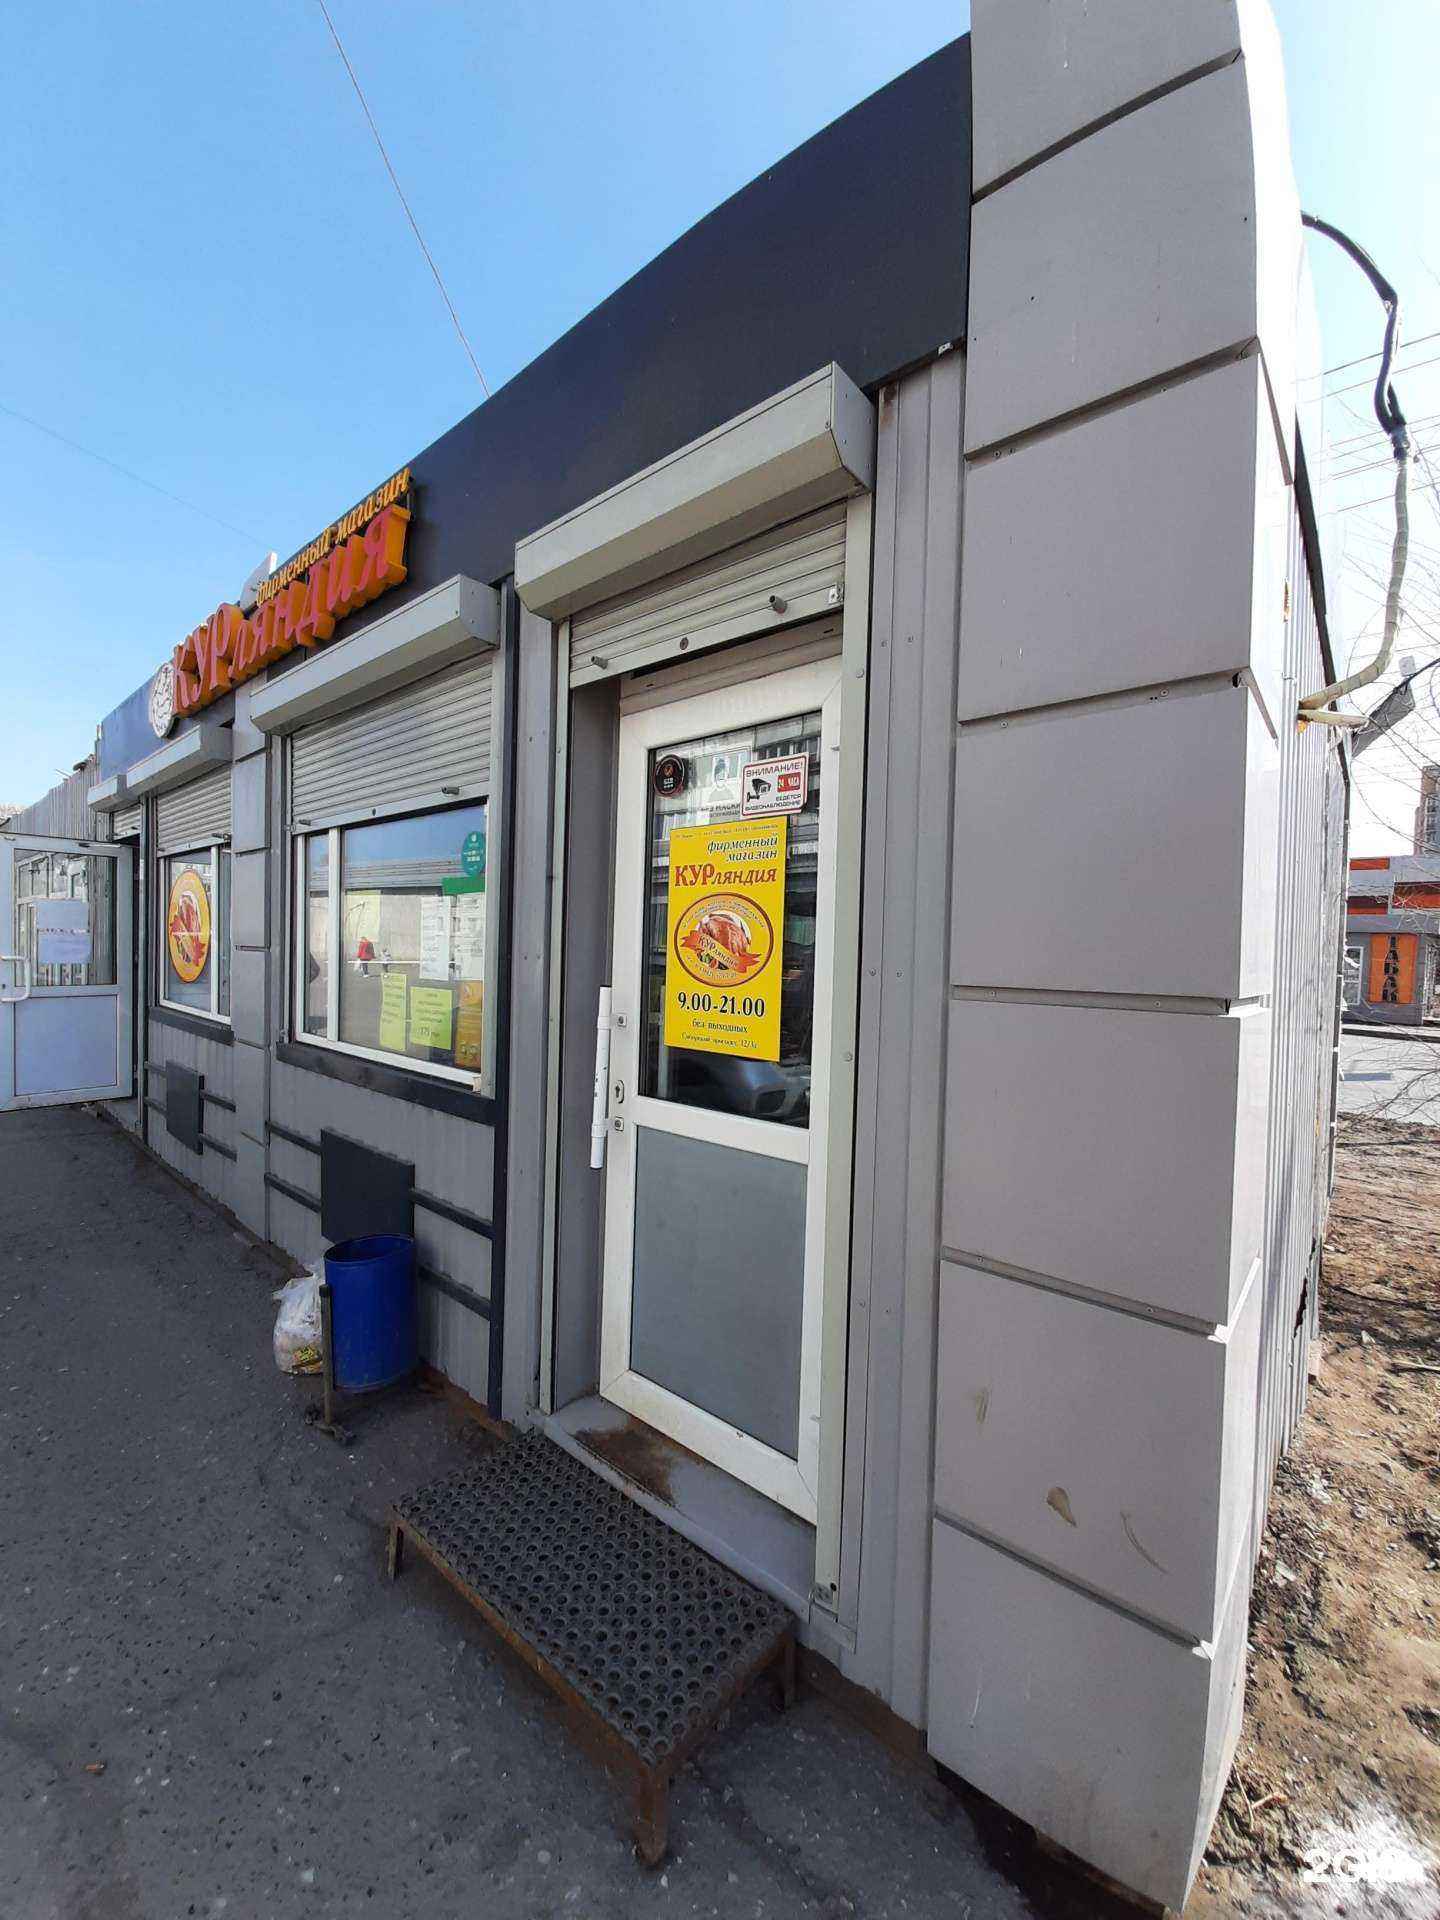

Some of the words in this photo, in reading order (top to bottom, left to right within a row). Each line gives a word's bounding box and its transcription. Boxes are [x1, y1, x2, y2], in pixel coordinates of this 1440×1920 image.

[746, 762, 804, 778] ВНИМАНИЕ!
[707, 832, 779, 854] фирменный
[726, 849, 778, 862] магазин
[678, 991, 765, 1017] 9.00-21.00
[708, 1022, 748, 1034] выходных
